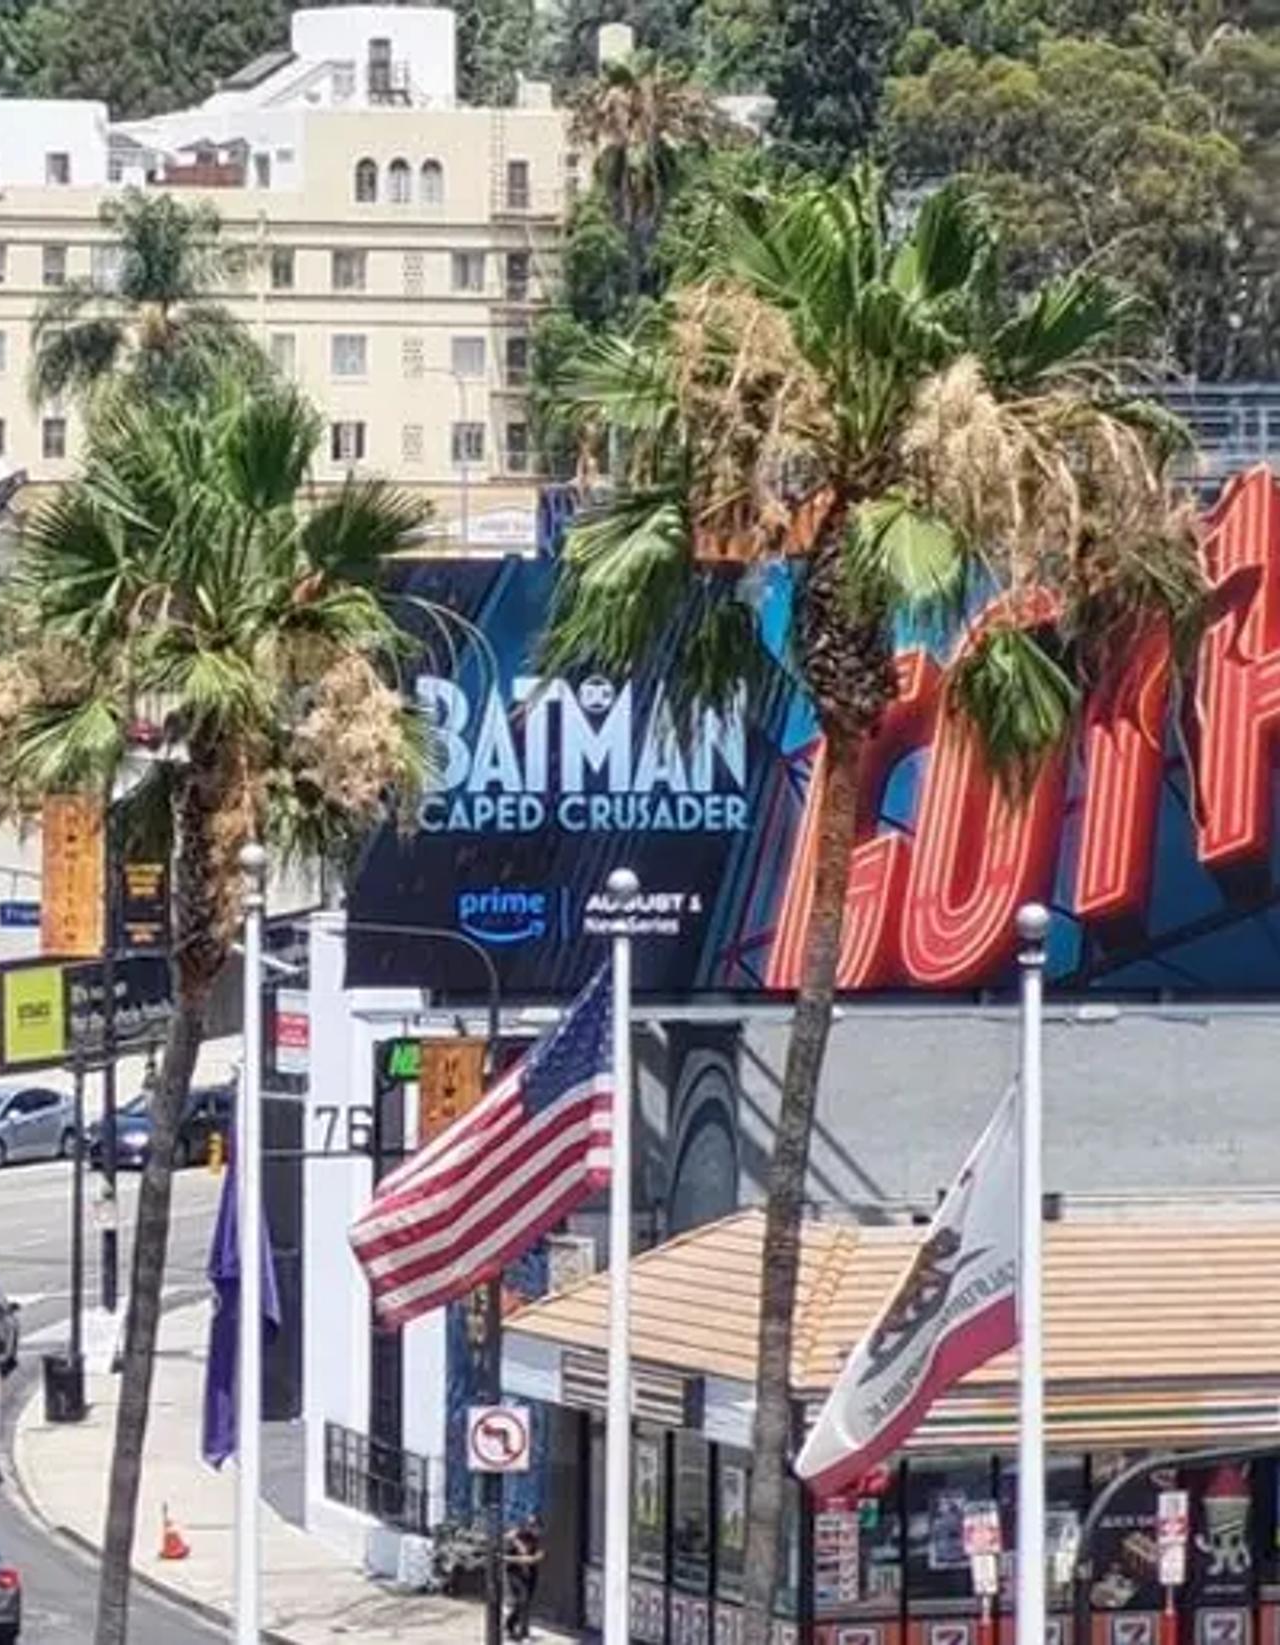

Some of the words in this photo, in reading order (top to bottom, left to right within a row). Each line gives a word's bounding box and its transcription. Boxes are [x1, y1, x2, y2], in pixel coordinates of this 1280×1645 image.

[415, 676, 747, 794] BATMAN
[416, 795, 545, 832] CAPED
[557, 794, 750, 833] CRUSADER
[459, 887, 546, 920] prime
[585, 893, 684, 912] AUGUST
